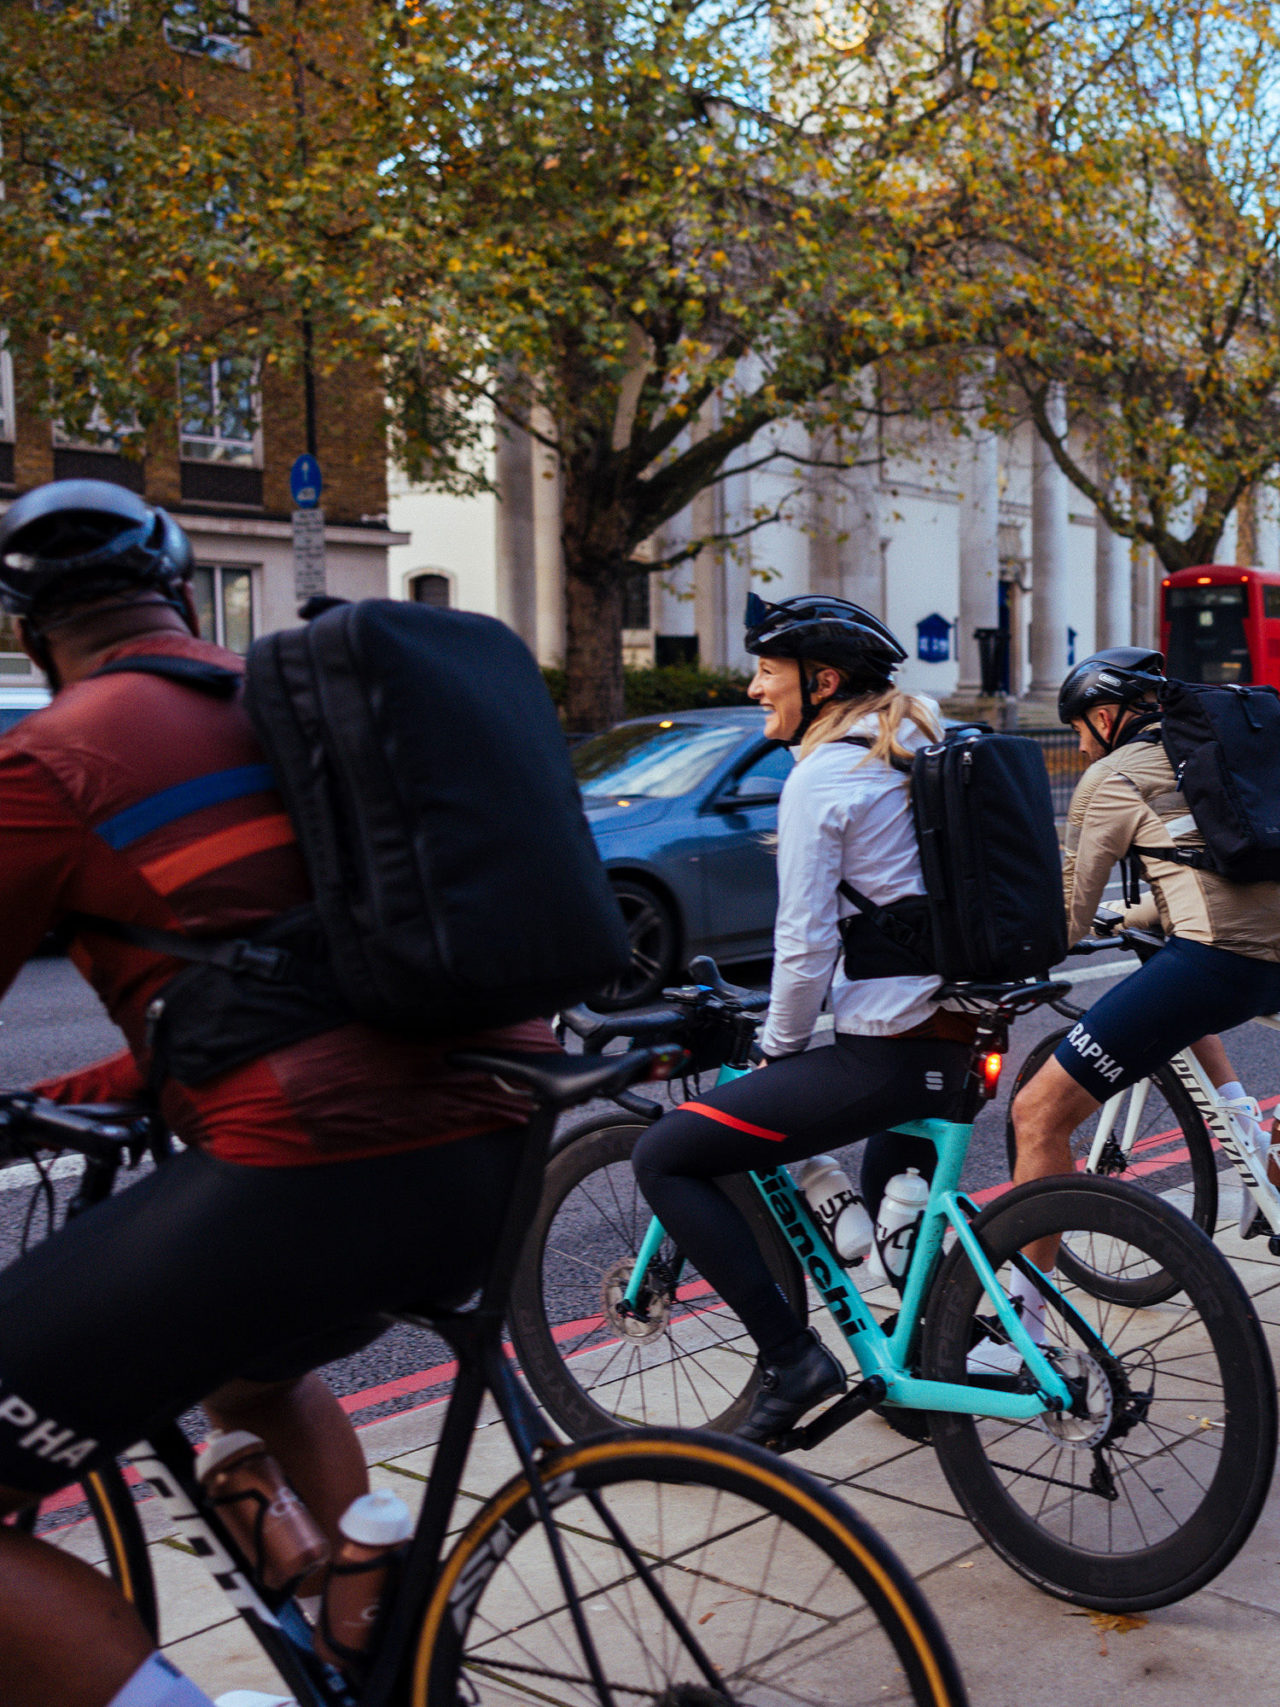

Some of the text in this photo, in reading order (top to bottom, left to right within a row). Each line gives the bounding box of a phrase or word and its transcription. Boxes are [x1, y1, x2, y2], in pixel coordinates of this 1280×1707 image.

[1066, 1023, 1125, 1084] RAPHA
[0, 1394, 98, 1468] PHA
[124, 1440, 283, 1629] IANT
